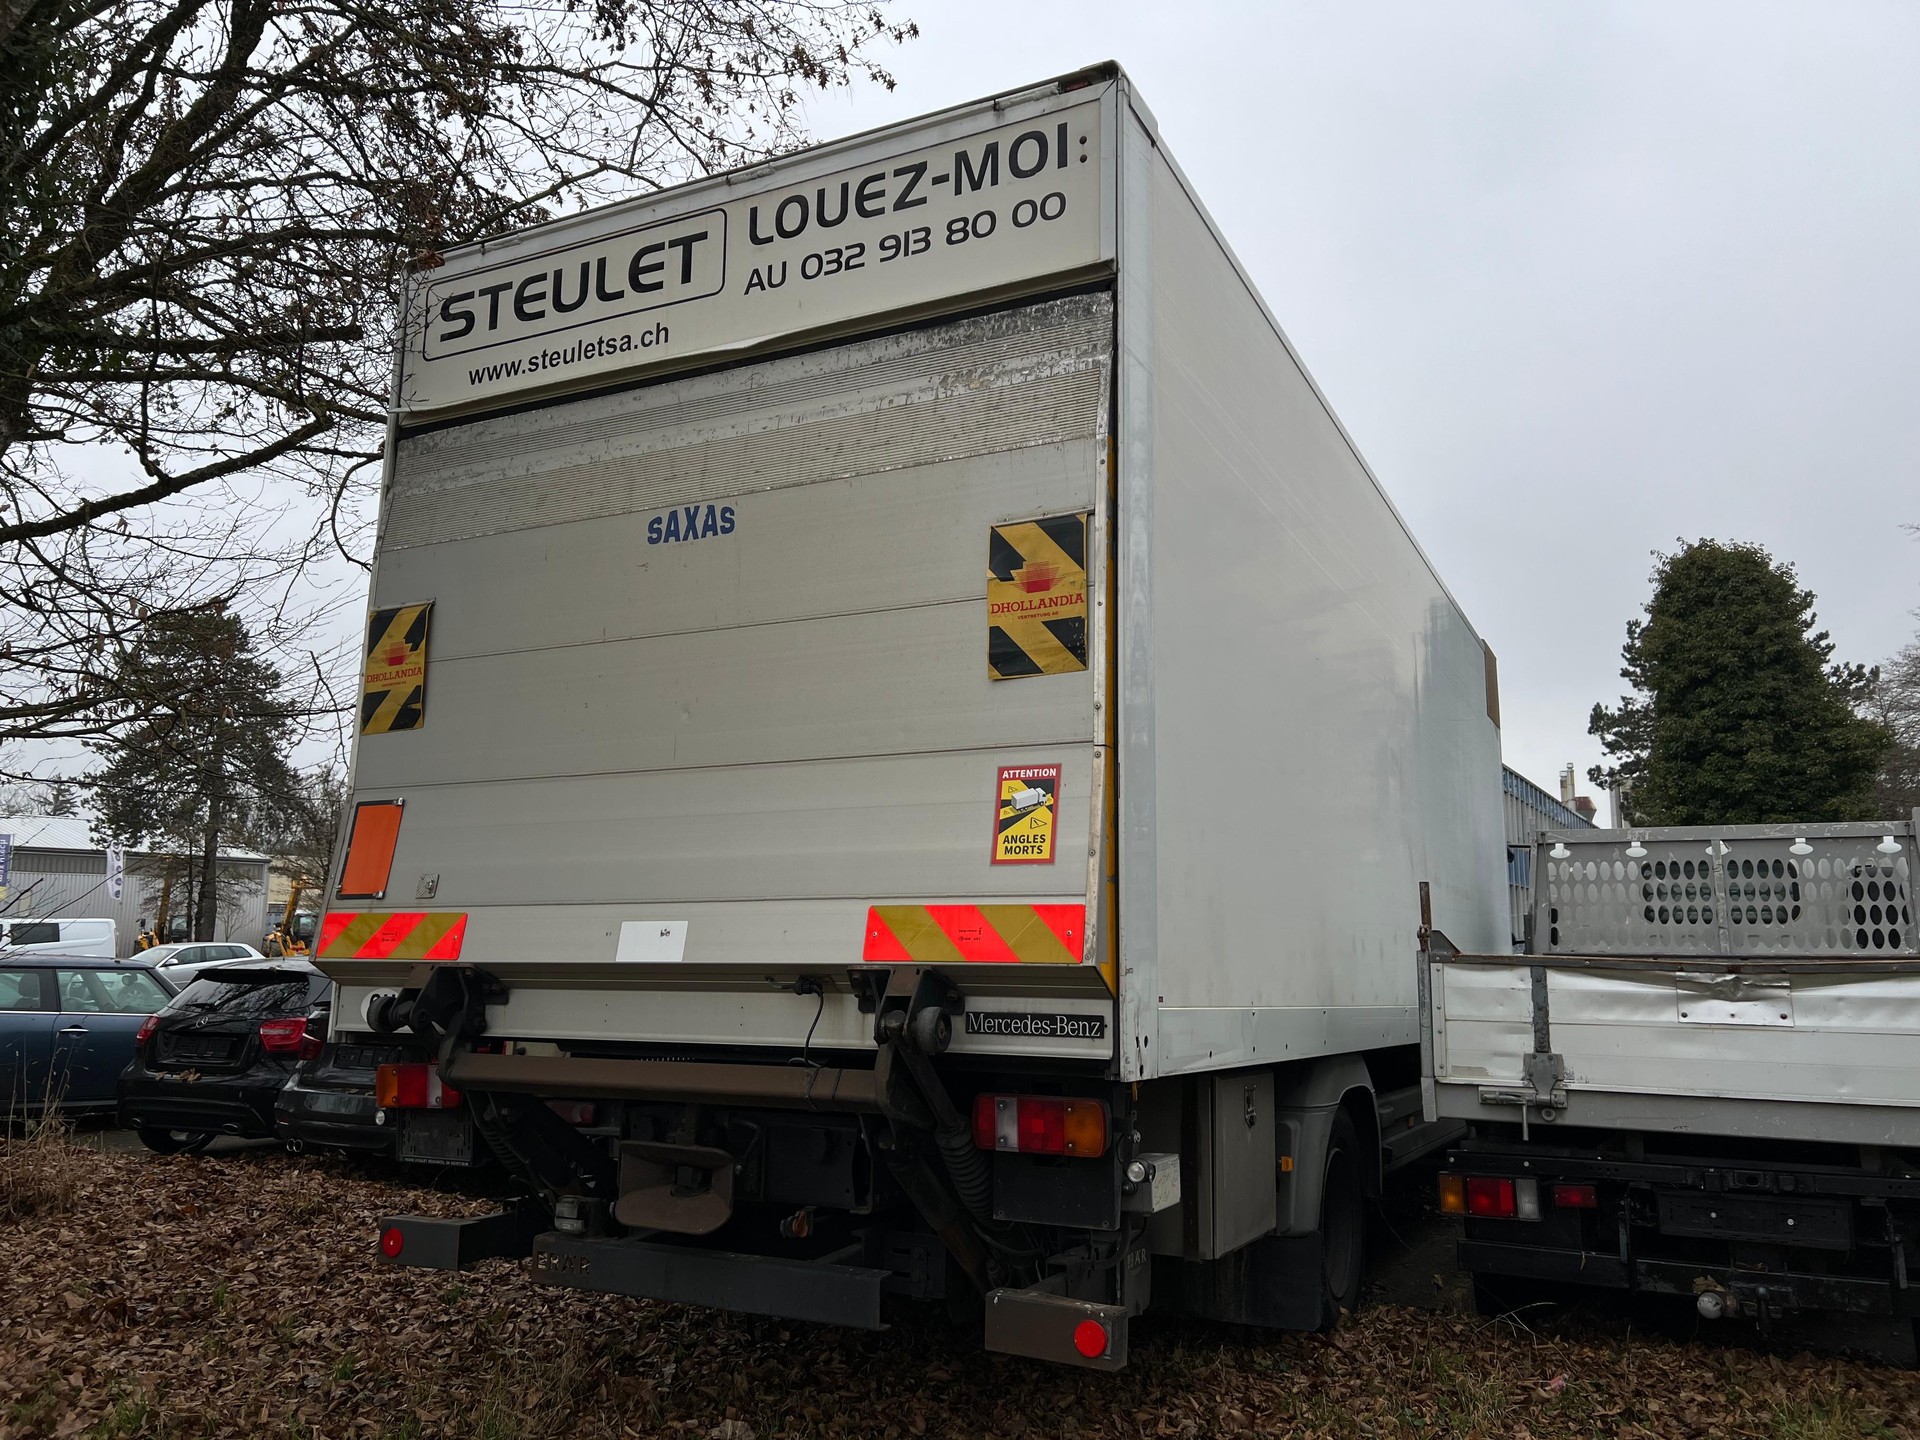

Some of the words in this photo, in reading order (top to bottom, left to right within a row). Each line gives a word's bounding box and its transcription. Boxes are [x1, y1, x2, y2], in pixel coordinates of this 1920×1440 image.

[744, 260, 787, 295] AU
[800, 242, 866, 280] 032
[879, 226, 932, 263] 913
[945, 209, 997, 245] 80
[1011, 191, 1067, 228] 00
[439, 230, 709, 343] STEULET
[468, 322, 670, 386] www.steuletsa.ch
[647, 504, 735, 545] SAXAS
[990, 593, 1085, 615] DHOLLANDIA
[1017, 612, 1050, 620] VERTRETUNG
[366, 666, 423, 684] DHOLLANDIA
[1002, 768, 1057, 779] ATTENTION
[1003, 834, 1046, 845] ANGLES
[1004, 844, 1043, 855] MORTS
[967, 1012, 1101, 1037] Mercedes-Benz
